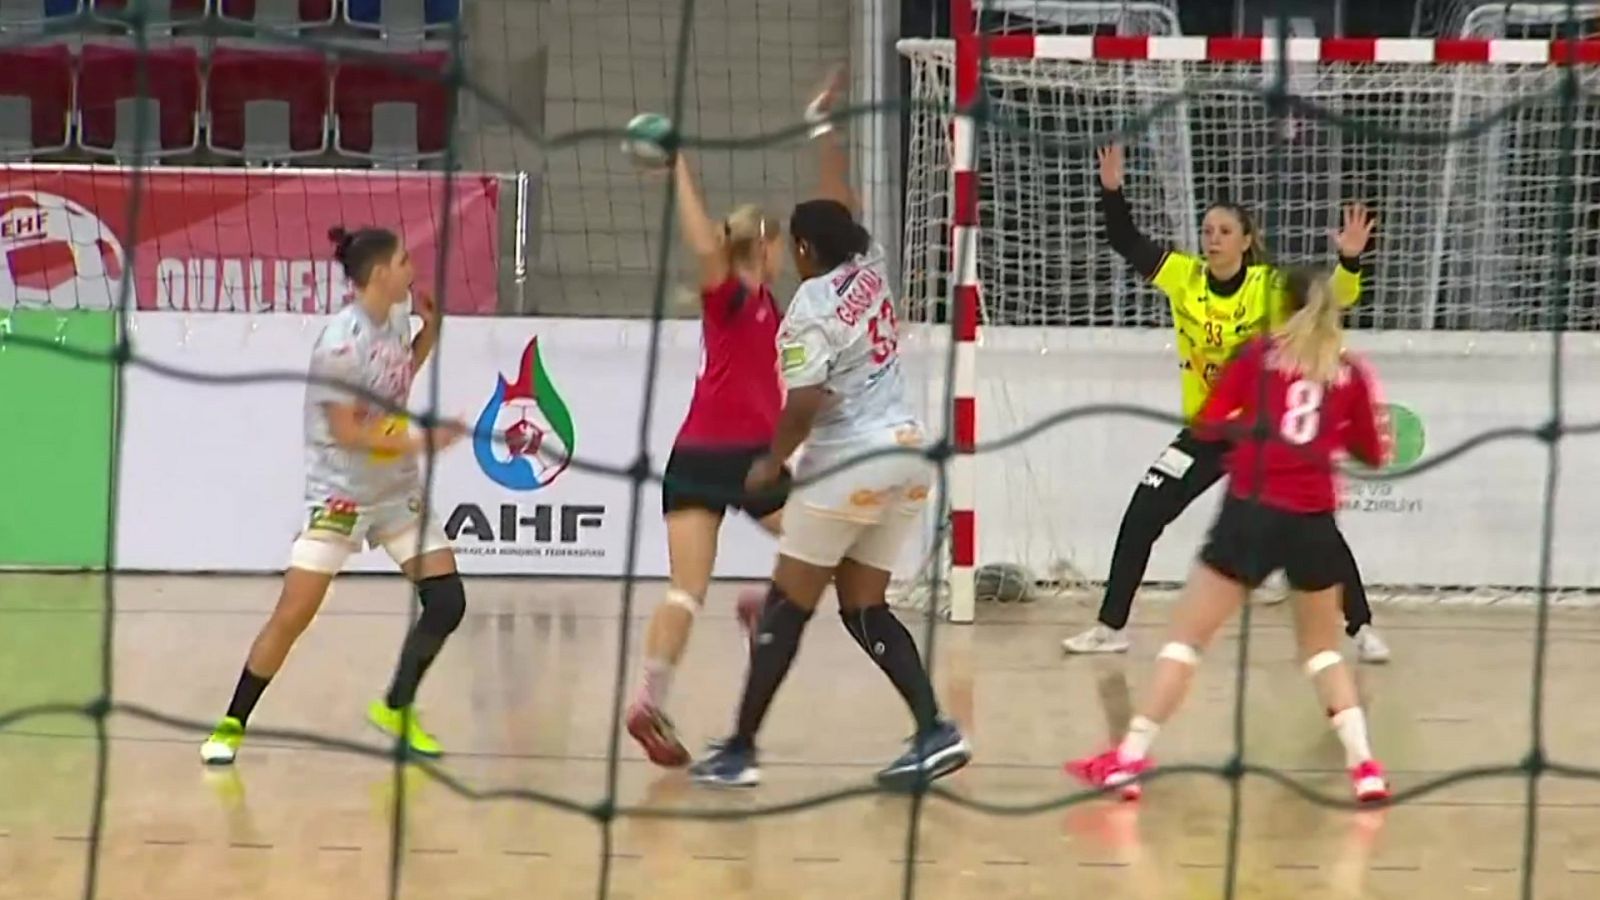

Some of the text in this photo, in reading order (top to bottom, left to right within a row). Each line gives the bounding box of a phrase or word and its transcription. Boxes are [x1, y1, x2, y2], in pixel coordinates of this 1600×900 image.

[1, 210, 48, 238] EHF
[1204, 321, 1223, 347] 33
[1280, 379, 1323, 444] 8
[444, 503, 605, 542] AHF
